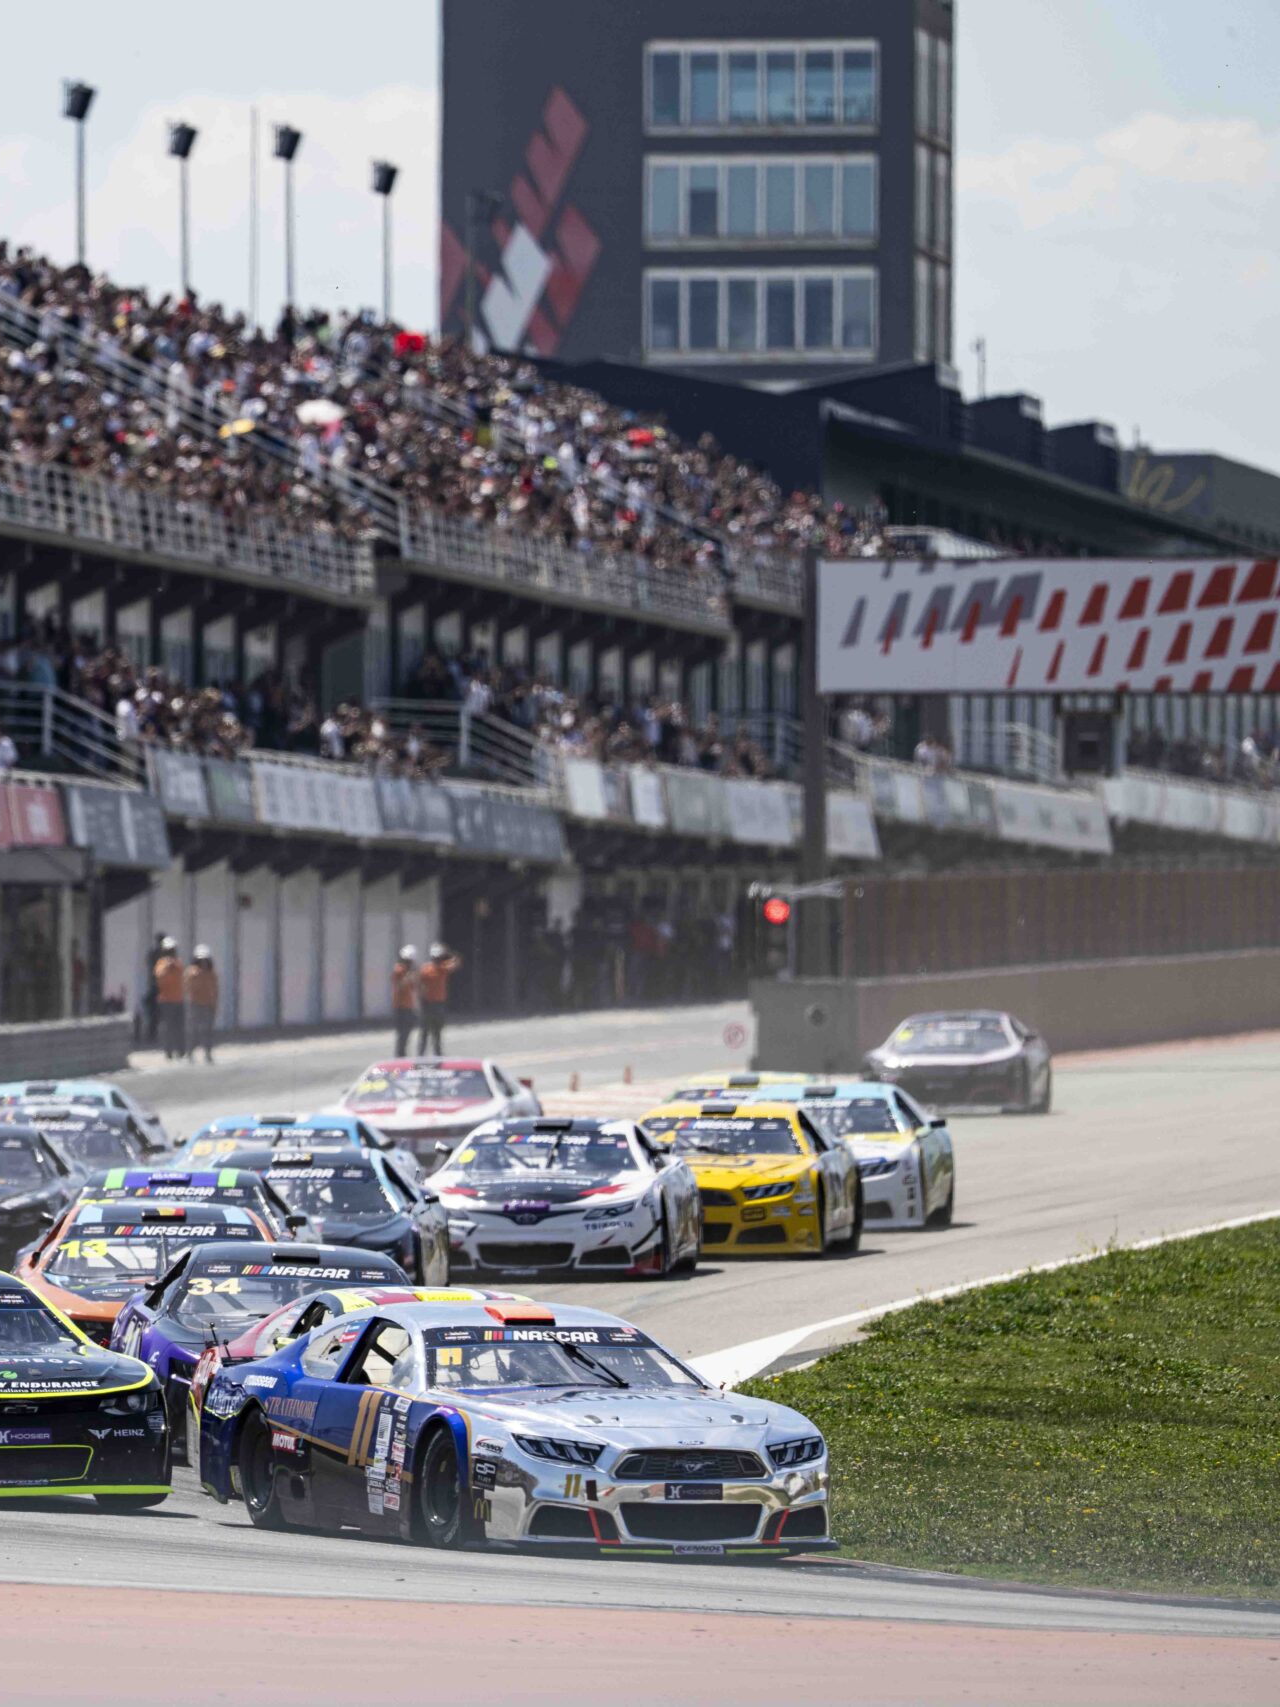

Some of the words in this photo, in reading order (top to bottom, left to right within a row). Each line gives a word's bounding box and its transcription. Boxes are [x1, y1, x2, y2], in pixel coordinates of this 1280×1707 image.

[265, 1168, 335, 1178] NASCAR
[154, 1187, 215, 1196] NASCAR
[140, 1226, 217, 1236] NASCAR
[60, 1240, 108, 1258] 13
[269, 1266, 350, 1280] NASCAR
[188, 1278, 242, 1296] 34
[513, 1331, 599, 1343] NASCAR
[11, 1380, 100, 1389] ENDURANCE
[265, 1397, 318, 1419] STRATHMORE
[114, 1429, 145, 1437] HEINZ
[272, 1433, 295, 1450] MOTUL
[563, 1474, 582, 1498] 11
